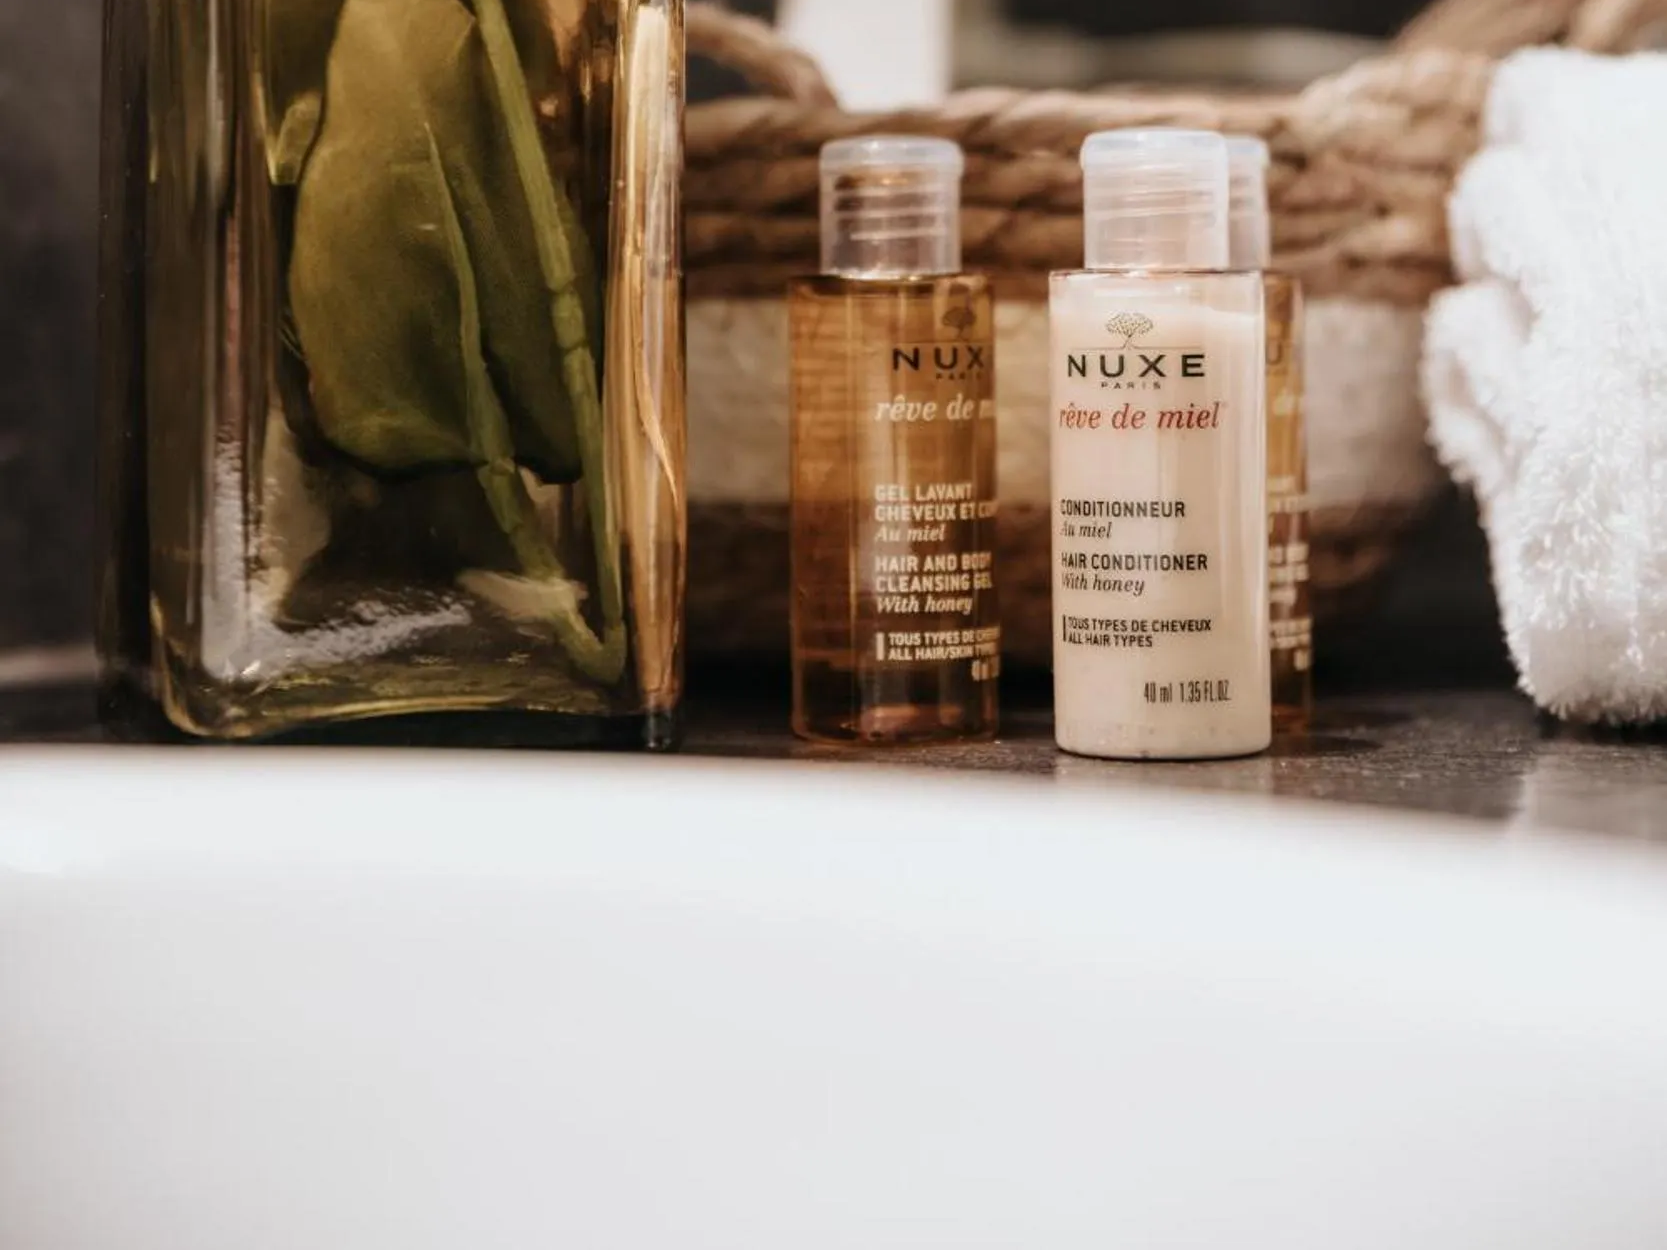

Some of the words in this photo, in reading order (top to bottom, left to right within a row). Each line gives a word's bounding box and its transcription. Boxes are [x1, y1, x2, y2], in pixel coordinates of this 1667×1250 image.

[1067, 354, 1206, 378] NUXE
[1101, 381, 1161, 390] PARIS
[875, 394, 937, 422] rêve
[946, 393, 974, 421] de
[1059, 403, 1101, 429] rêve
[1111, 402, 1147, 430] de
[1157, 401, 1221, 430] miel
[915, 484, 972, 501] LAVANT
[875, 502, 957, 521] CHEVEUX
[960, 501, 976, 519] ET
[1061, 499, 1186, 518] CONDITIONNEUR
[875, 524, 901, 542] Au
[907, 523, 947, 542] miel
[1079, 521, 1112, 538] miel
[875, 554, 919, 572] HAIR
[923, 553, 958, 572] AND
[1061, 552, 1087, 569] HAIR
[1091, 553, 1208, 571] CONDITIONER
[875, 573, 971, 593] CLEANSING
[1061, 573, 1088, 591] With
[1093, 574, 1145, 597] honey
[876, 594, 920, 613] With
[924, 595, 973, 617] honey
[1092, 618, 1128, 632] TYPES
[1131, 619, 1148, 633] DE
[1152, 619, 1212, 633] CHEVEUX
[888, 632, 921, 646] TOUS
[924, 631, 960, 645] TYPES
[1068, 631, 1083, 645] ALL
[1085, 633, 1111, 647] HAIR
[1114, 634, 1153, 648] TYPES
[887, 647, 913, 661] ALL
[1144, 682, 1156, 704] 40
[1160, 682, 1173, 703] ml
[1179, 681, 1201, 702] 1.35
